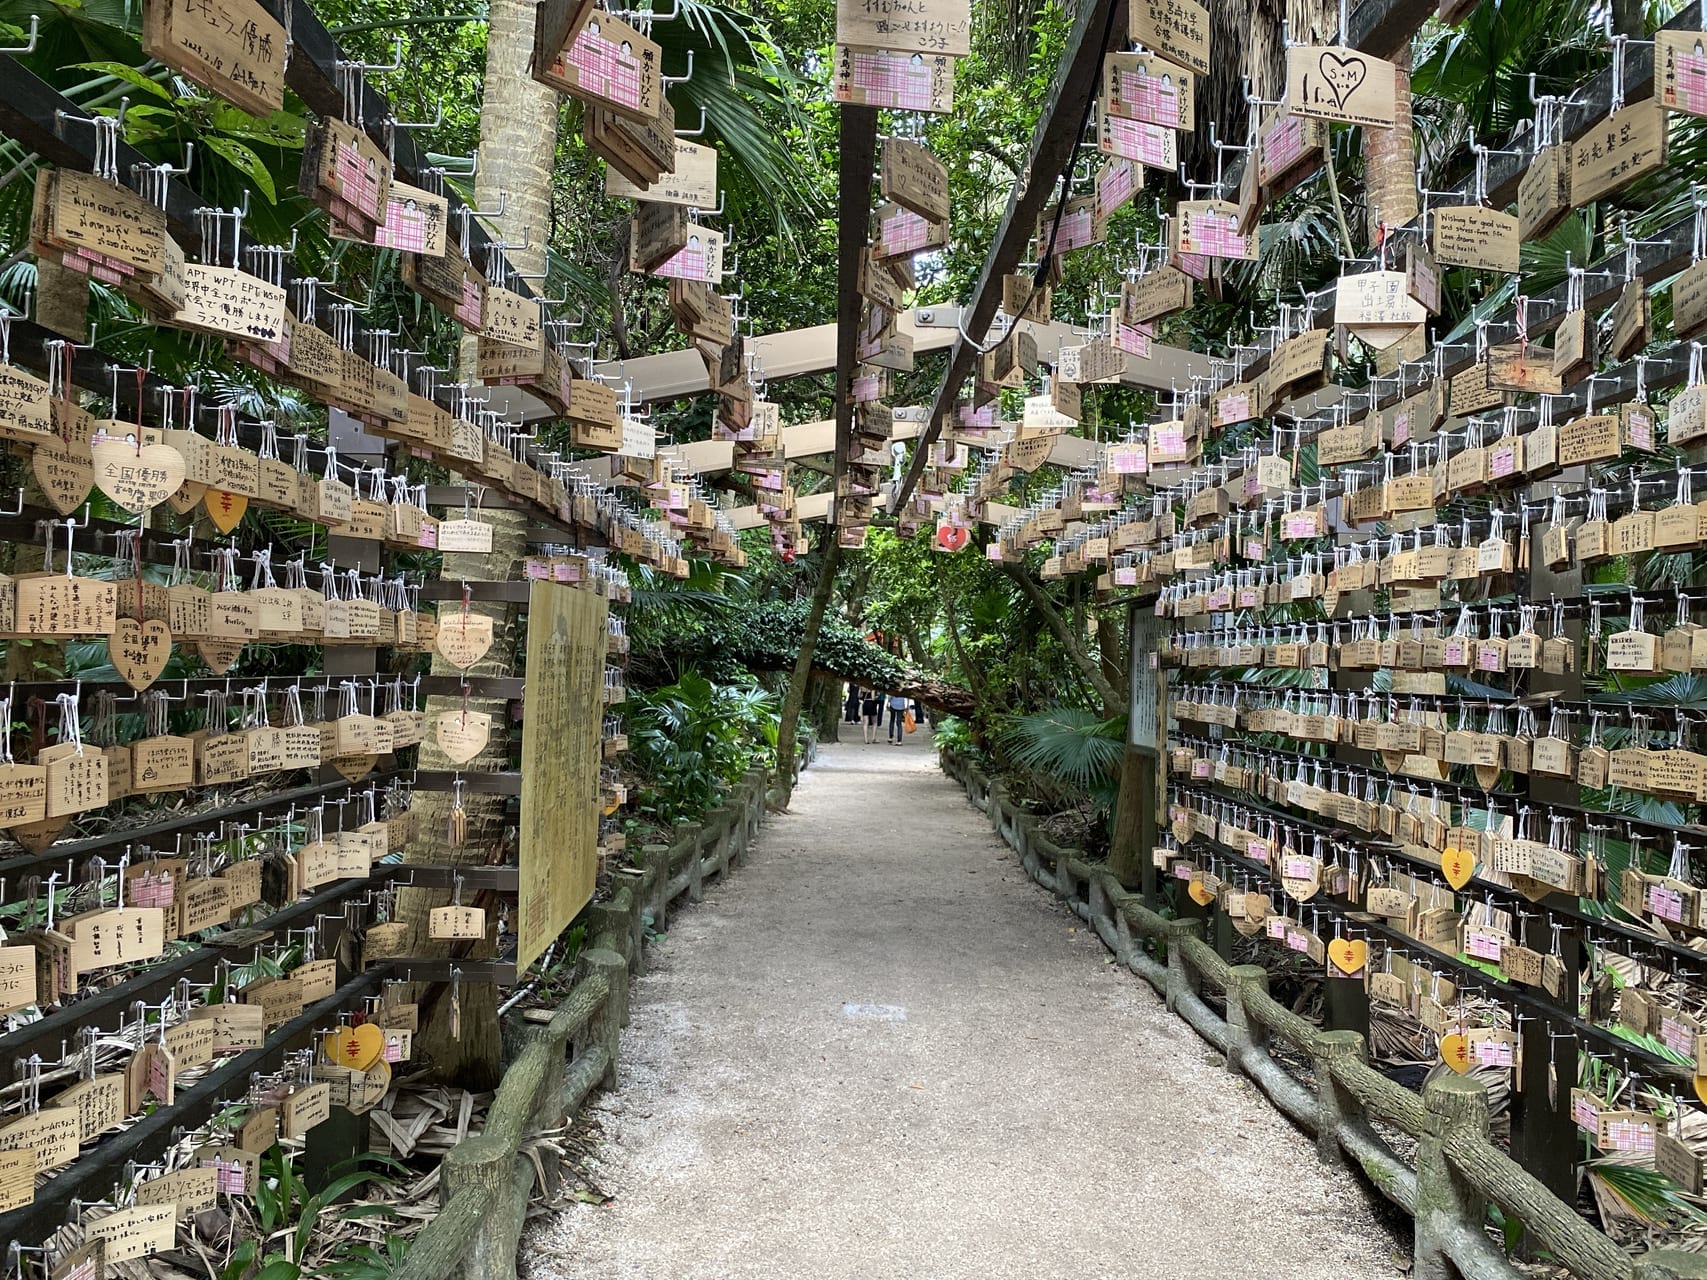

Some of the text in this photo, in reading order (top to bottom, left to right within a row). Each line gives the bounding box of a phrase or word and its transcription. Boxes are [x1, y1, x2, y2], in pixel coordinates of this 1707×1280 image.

[1167, 1, 1198, 26] 宮崎大学
[1154, 26, 1171, 41] 合格
[641, 49, 653, 108] 願かけびな
[839, 46, 852, 91] 青島神社
[1666, 44, 1675, 95] 青島神社
[932, 56, 947, 109] 願かけびな
[1111, 65, 1120, 106] 青島神社
[1178, 76, 1188, 125] 願かけびな
[1163, 126, 1173, 164] かけびな
[427, 203, 440, 250] 願かけびな
[1441, 213, 1466, 227] Wishing
[1481, 220, 1494, 229] good
[1456, 226, 1489, 236] stress-free
[1440, 242, 1455, 250] Good
[1456, 234, 1475, 243] drama
[707, 237, 716, 278] 願かけびな
[187, 268, 285, 303] APT WPT EPT WSOP
[1358, 280, 1399, 293] 甲子園
[105, 463, 168, 483] 全国優勝
[1451, 861, 1461, 877] 幸
[1344, 950, 1354, 962] 幸
[346, 1040, 360, 1057] 幸
[1456, 1046, 1466, 1061] 幸
